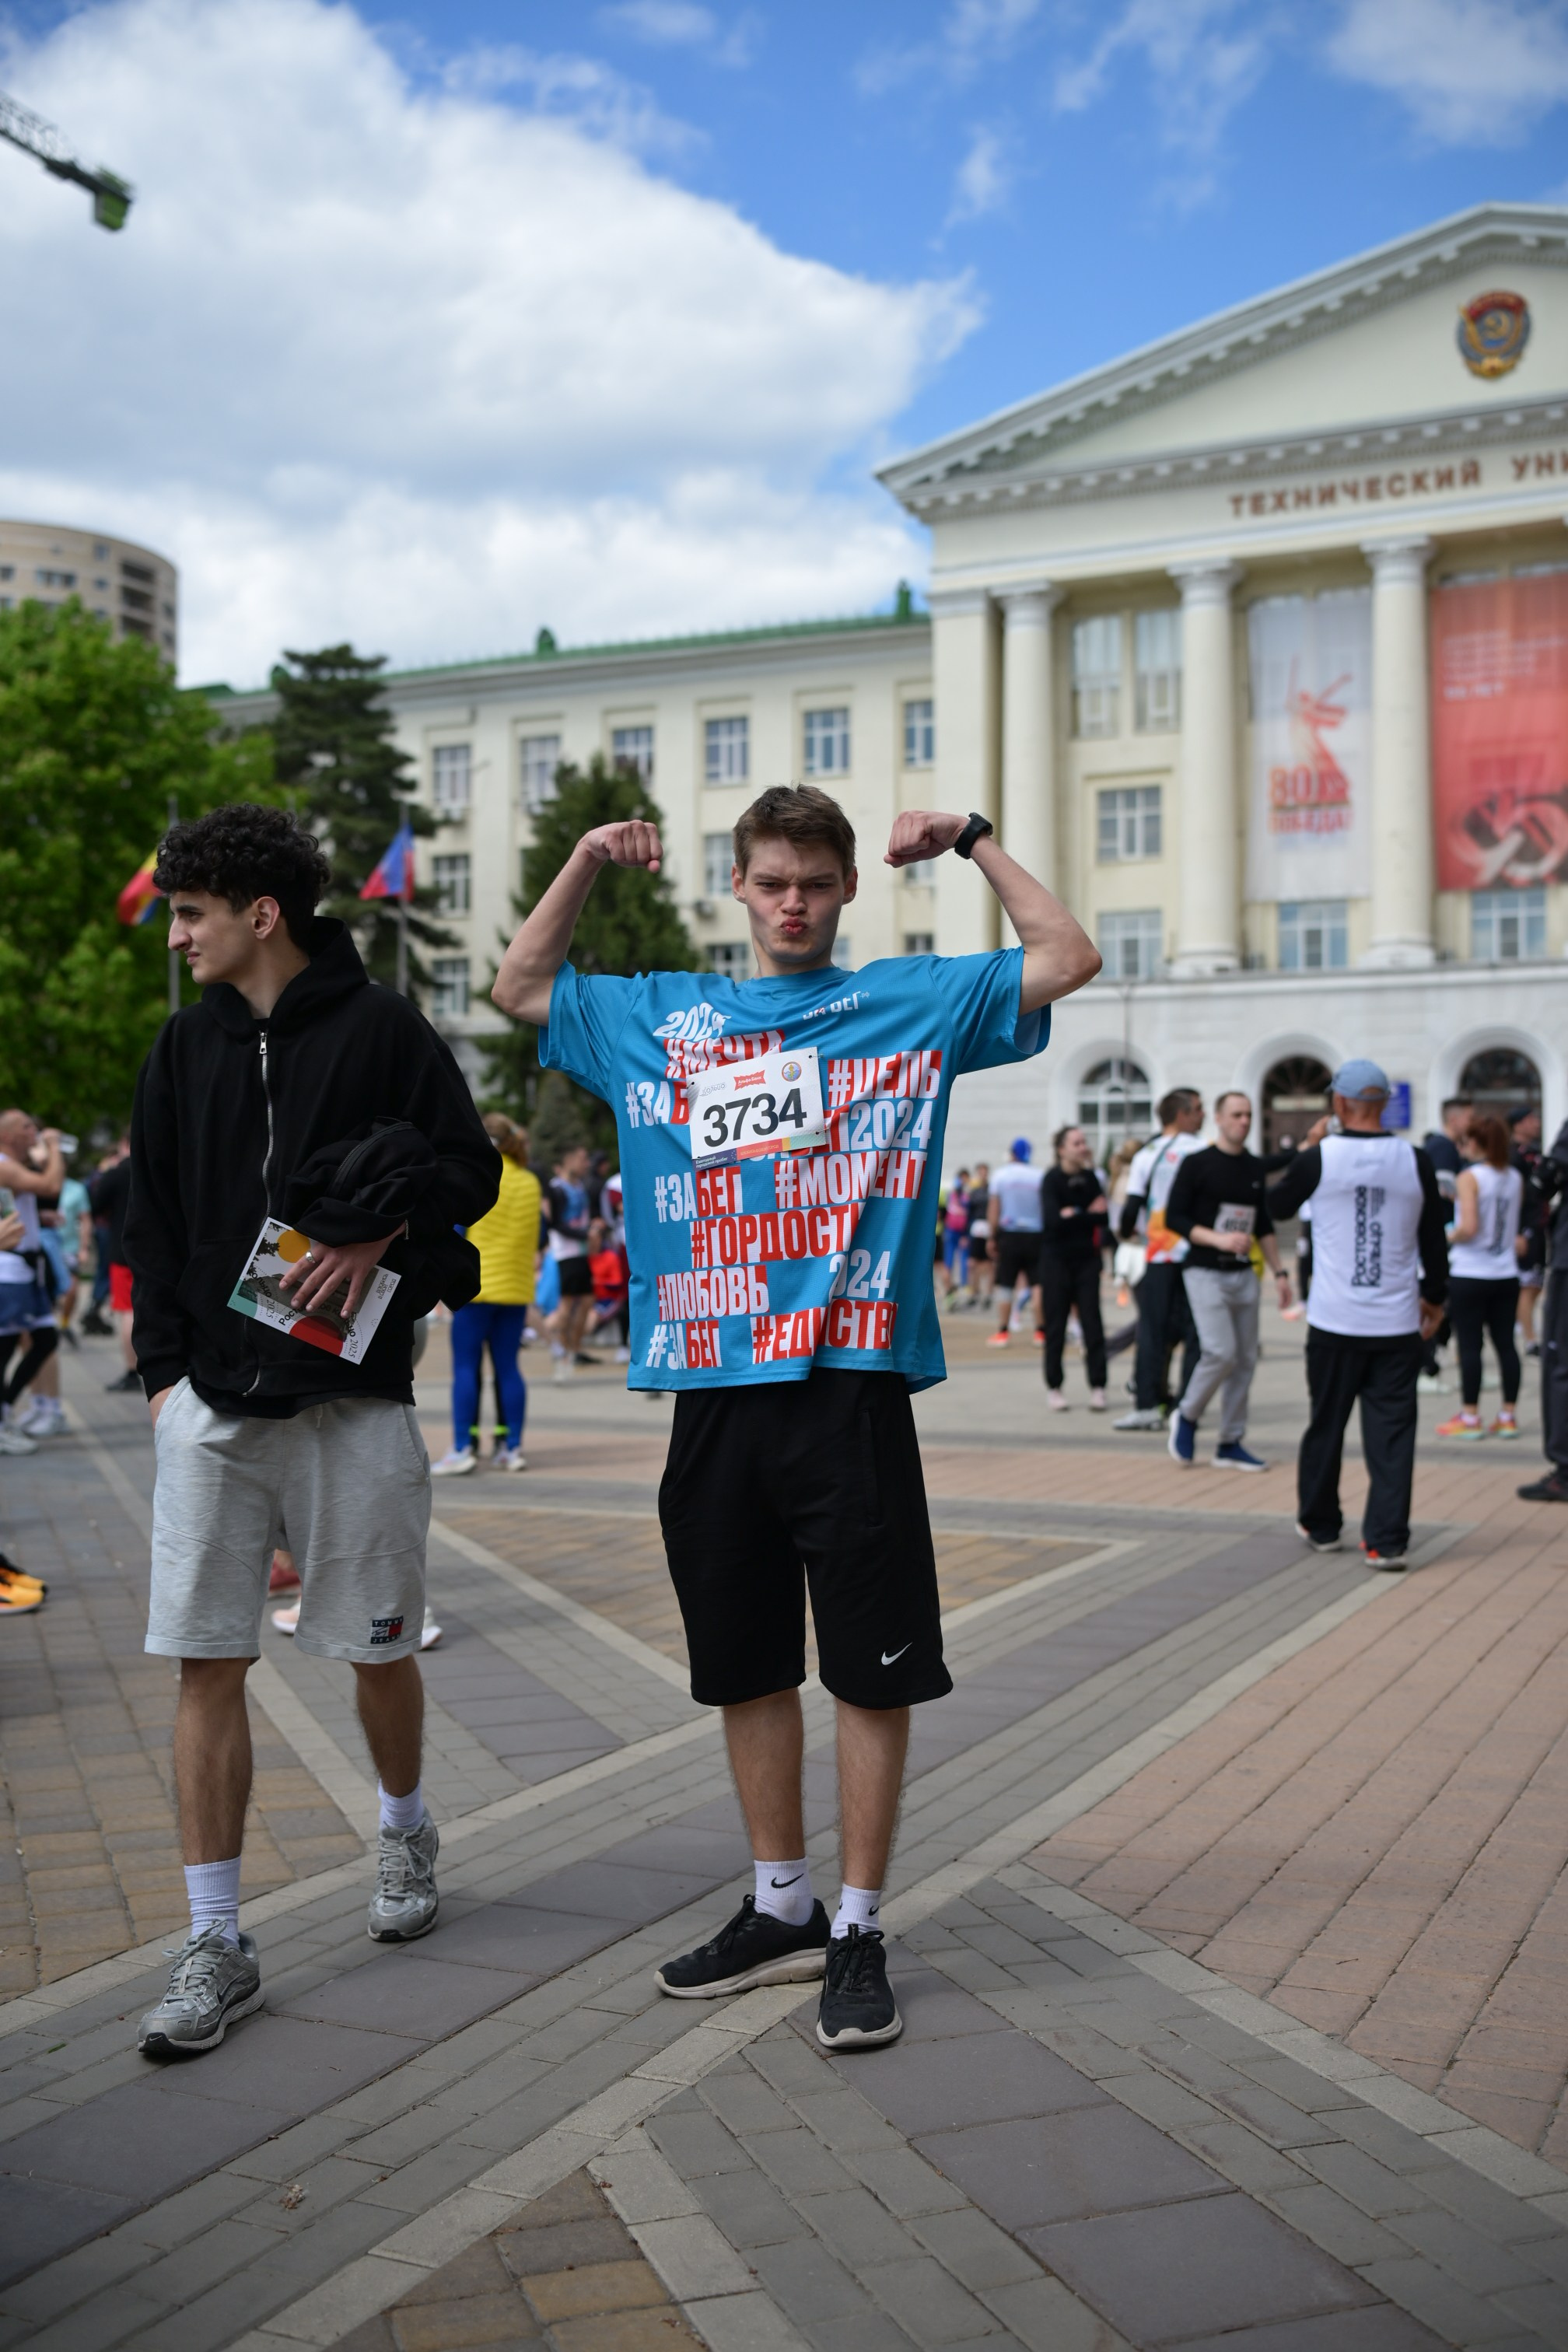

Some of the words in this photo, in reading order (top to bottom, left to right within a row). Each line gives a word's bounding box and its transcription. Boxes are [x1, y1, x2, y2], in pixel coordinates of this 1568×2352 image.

[1229, 459, 1481, 519] ТЕХНИЧЕСКИЙ
[653, 1003, 731, 1041] 2024
[625, 1081, 689, 1128] #ЗАБ
[828, 1051, 940, 1107] #ЦЕЛЬ
[703, 1087, 807, 1148] 3734
[655, 1166, 741, 1223] #ЗАБЕГ
[775, 1151, 926, 1208] #МОМЕНТ
[691, 1202, 860, 1268] #ГОРДОСТ
[659, 1265, 769, 1321] #ЛЮБОВЬ
[348, 1338, 359, 1360] 2025
[646, 1320, 720, 1370] #ЗАБЕГ
